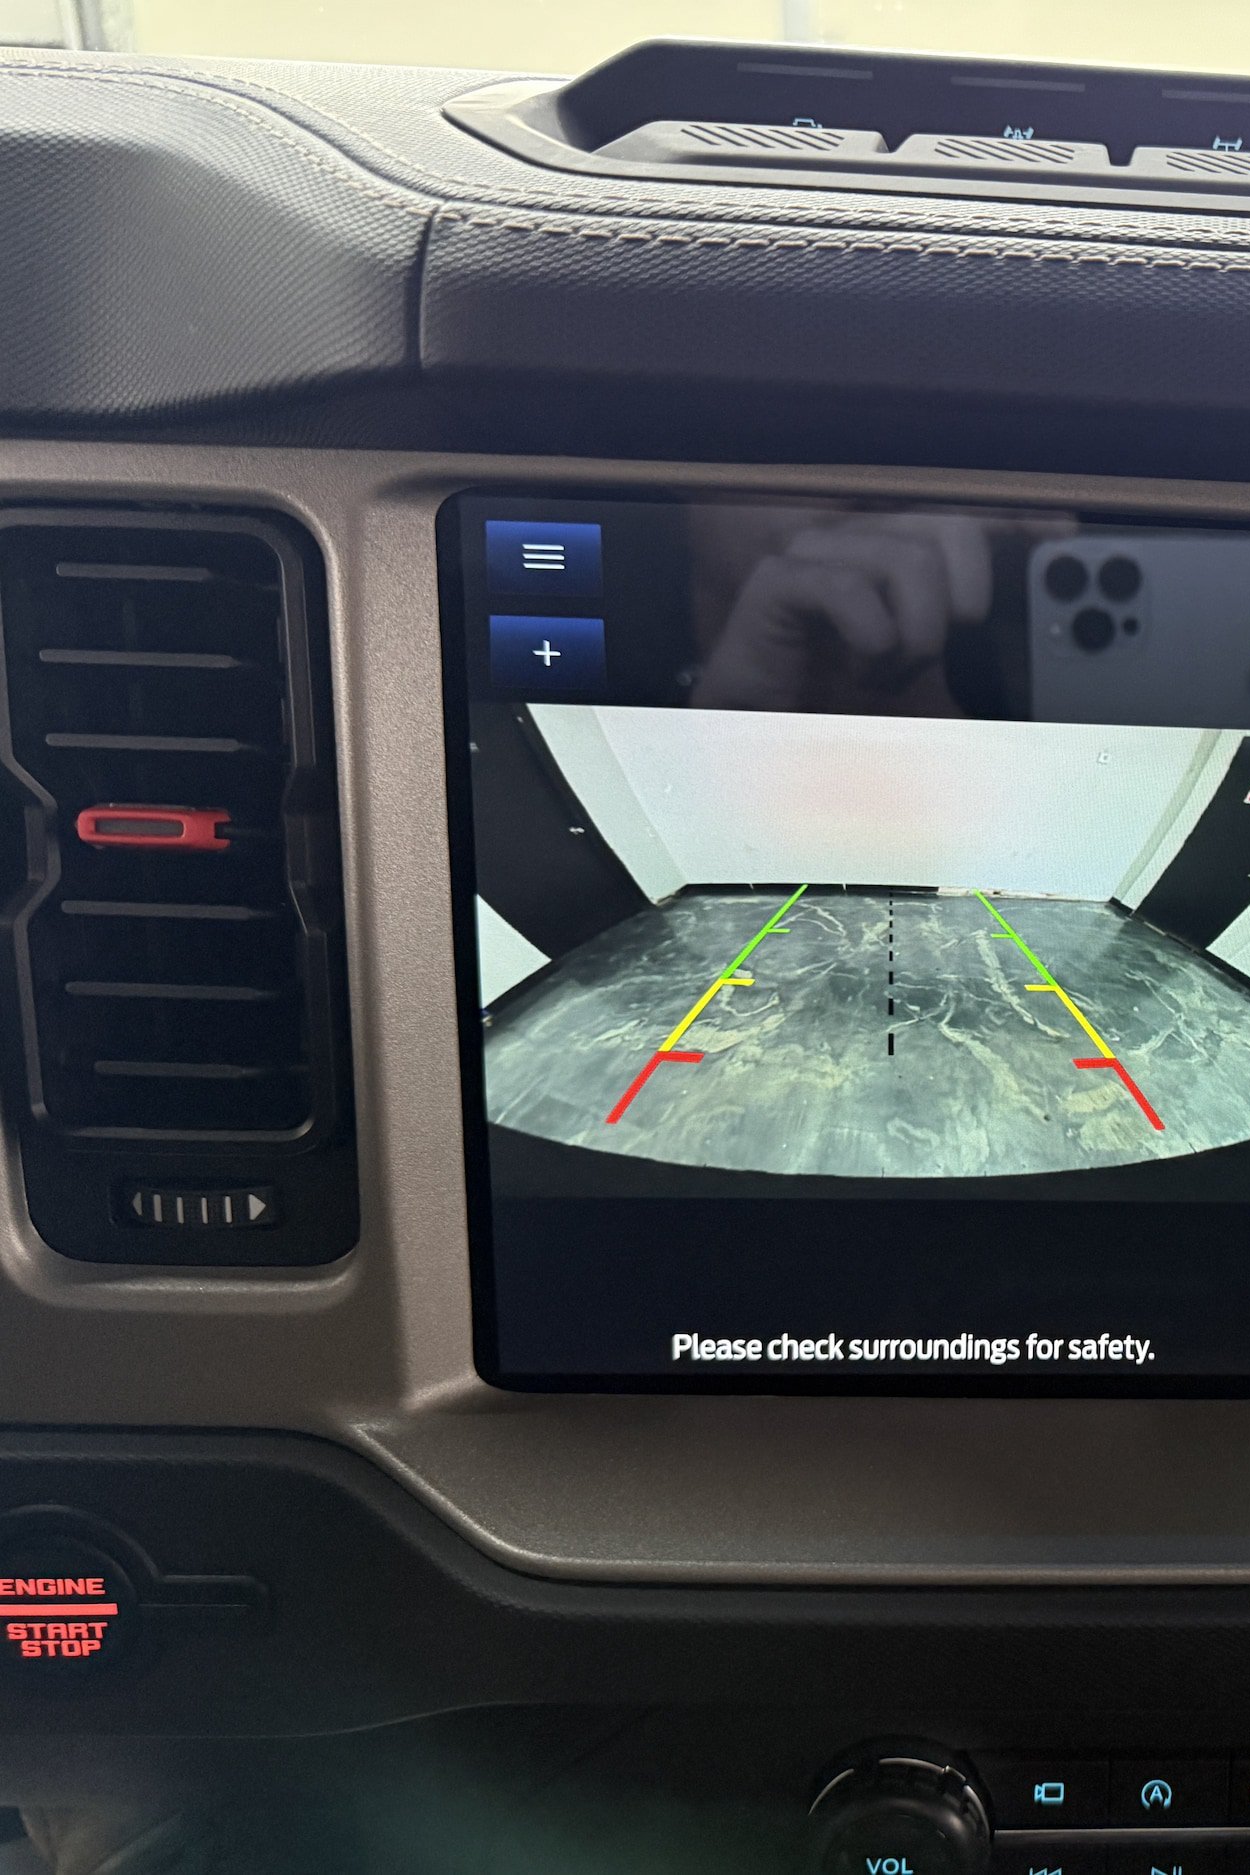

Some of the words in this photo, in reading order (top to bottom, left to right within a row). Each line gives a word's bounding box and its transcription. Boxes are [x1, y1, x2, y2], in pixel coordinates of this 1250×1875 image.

[671, 1332, 763, 1361] Please
[766, 1332, 845, 1361] check
[848, 1333, 1021, 1366] surroundings
[1025, 1333, 1064, 1361] for
[1067, 1333, 1156, 1365] safety.
[0, 1577, 106, 1596] ENGINE
[6, 1622, 108, 1640] START
[21, 1640, 102, 1657] STOP
[865, 1857, 914, 1875] VOL
